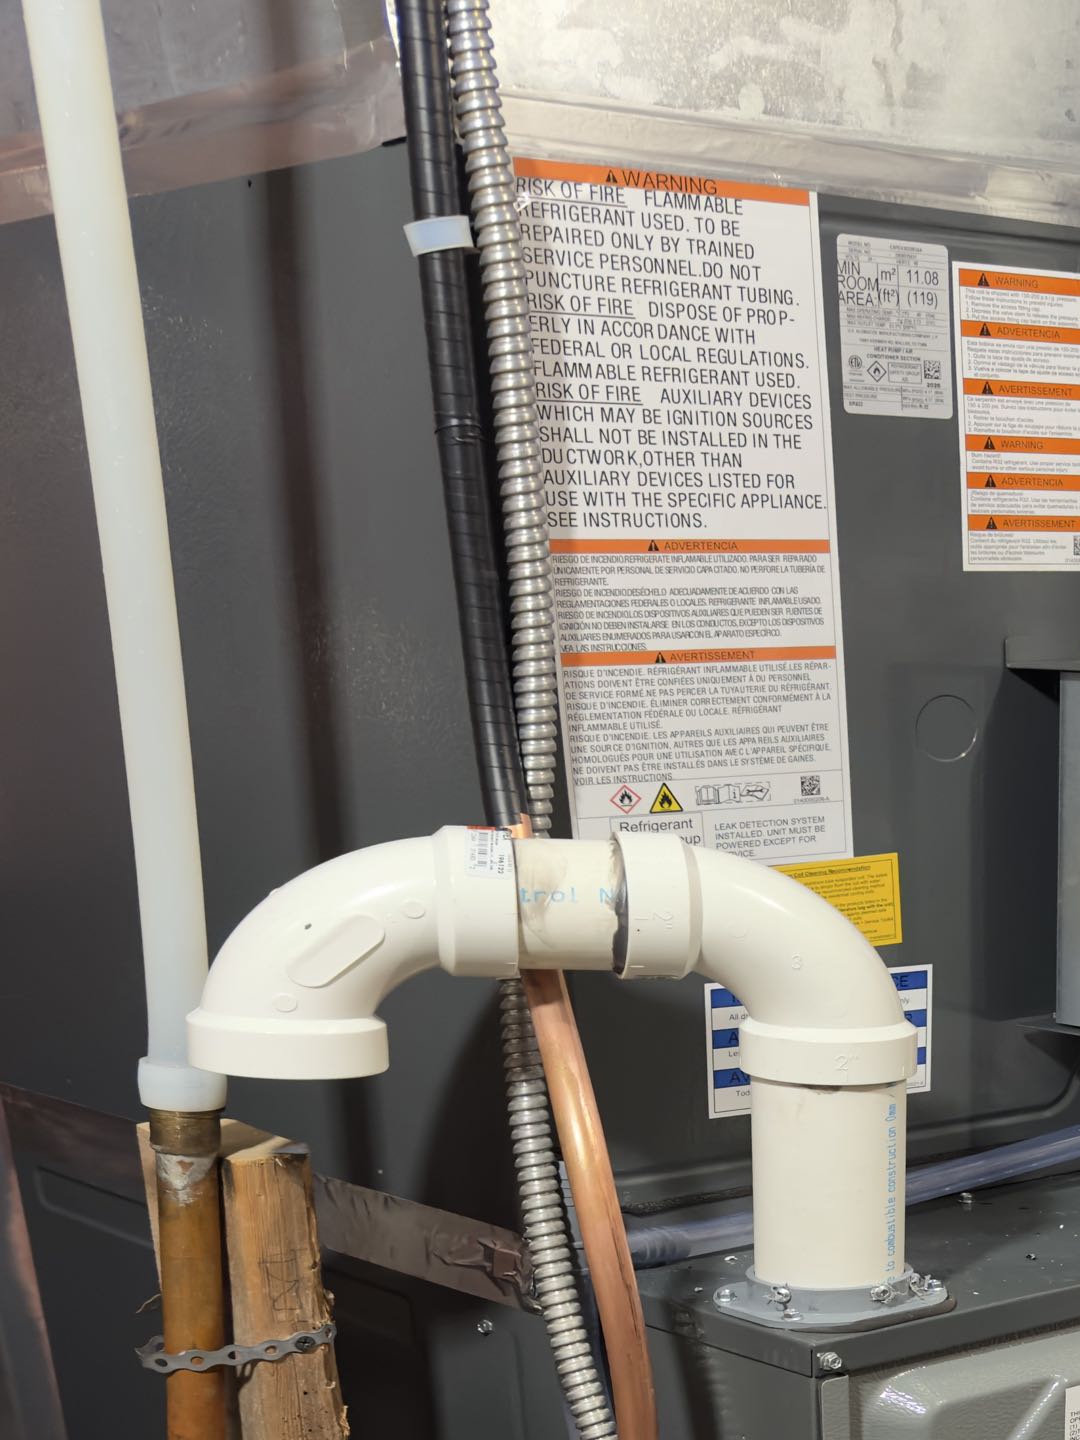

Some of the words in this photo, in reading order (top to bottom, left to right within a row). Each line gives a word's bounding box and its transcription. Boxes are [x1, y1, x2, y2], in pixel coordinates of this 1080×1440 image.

[622, 170, 718, 195] WARNING
[516, 177, 556, 198] RISK
[560, 182, 583, 199] OF
[590, 184, 626, 204] FIRE
[644, 191, 743, 215] FLAMMABLE
[518, 201, 635, 227] REFRIGERANT
[641, 212, 690, 232] USED.
[694, 216, 716, 234] TO
[721, 220, 740, 237] BE
[520, 224, 604, 247] REPAIRED
[611, 231, 654, 251] ONLY
[660, 236, 680, 253] BY
[686, 238, 754, 260] TRAINED
[522, 246, 594, 268] SERVICE
[730, 264, 761, 282] NOT
[838, 260, 861, 276] MIN
[838, 274, 878, 292] ROOM
[907, 269, 939, 286] 11.08
[995, 276, 1039, 288] WARNING
[525, 270, 616, 293] PUNCTURE
[622, 278, 732, 301] REFRIGERANT
[737, 286, 800, 306] TUBING.
[908, 290, 938, 309] (119)
[997, 327, 1060, 339] ADVERTENCIA
[536, 382, 574, 399] RISK
[578, 384, 600, 400] OF
[606, 385, 642, 402] FIRE
[660, 388, 742, 406] AUXILIARY
[750, 392, 812, 410] DEVICES
[999, 385, 1073, 397] AVERTISSEMENT
[1000, 440, 1044, 450] WARNING
[1001, 477, 1064, 488] ADVERTENCIA
[545, 491, 578, 507] USE
[583, 491, 626, 507] WITH
[632, 492, 662, 508] THE
[667, 492, 736, 508] SPECIFIC
[740, 494, 827, 510] APPLIANCE.
[547, 512, 578, 528] SEE
[584, 512, 707, 528] INSTRUCTIONS.
[1002, 518, 1076, 528] AVERTISSEMENT
[664, 541, 738, 551] ADVERTENCIA
[670, 650, 756, 662] AVERTISSEMENT
[563, 670, 595, 678] RISQUE
[648, 666, 700, 676] RÉFRIGÉRANT
[704, 664, 757, 674] INFLAMMABLE
[620, 818, 694, 834] Refrigerant
[715, 822, 737, 831] LEAK
[740, 818, 788, 830] DETECTION
[791, 816, 825, 826] SYSTEM
[767, 828, 787, 837] UNIT
[789, 826, 812, 836] MUST
[815, 824, 826, 833] BE
[716, 838, 761, 850] POWERED
[764, 837, 796, 847] EXCEPT
[799, 835, 816, 844] FOR
[886, 1126, 896, 1193] construction
[886, 1197, 896, 1256] combustible
